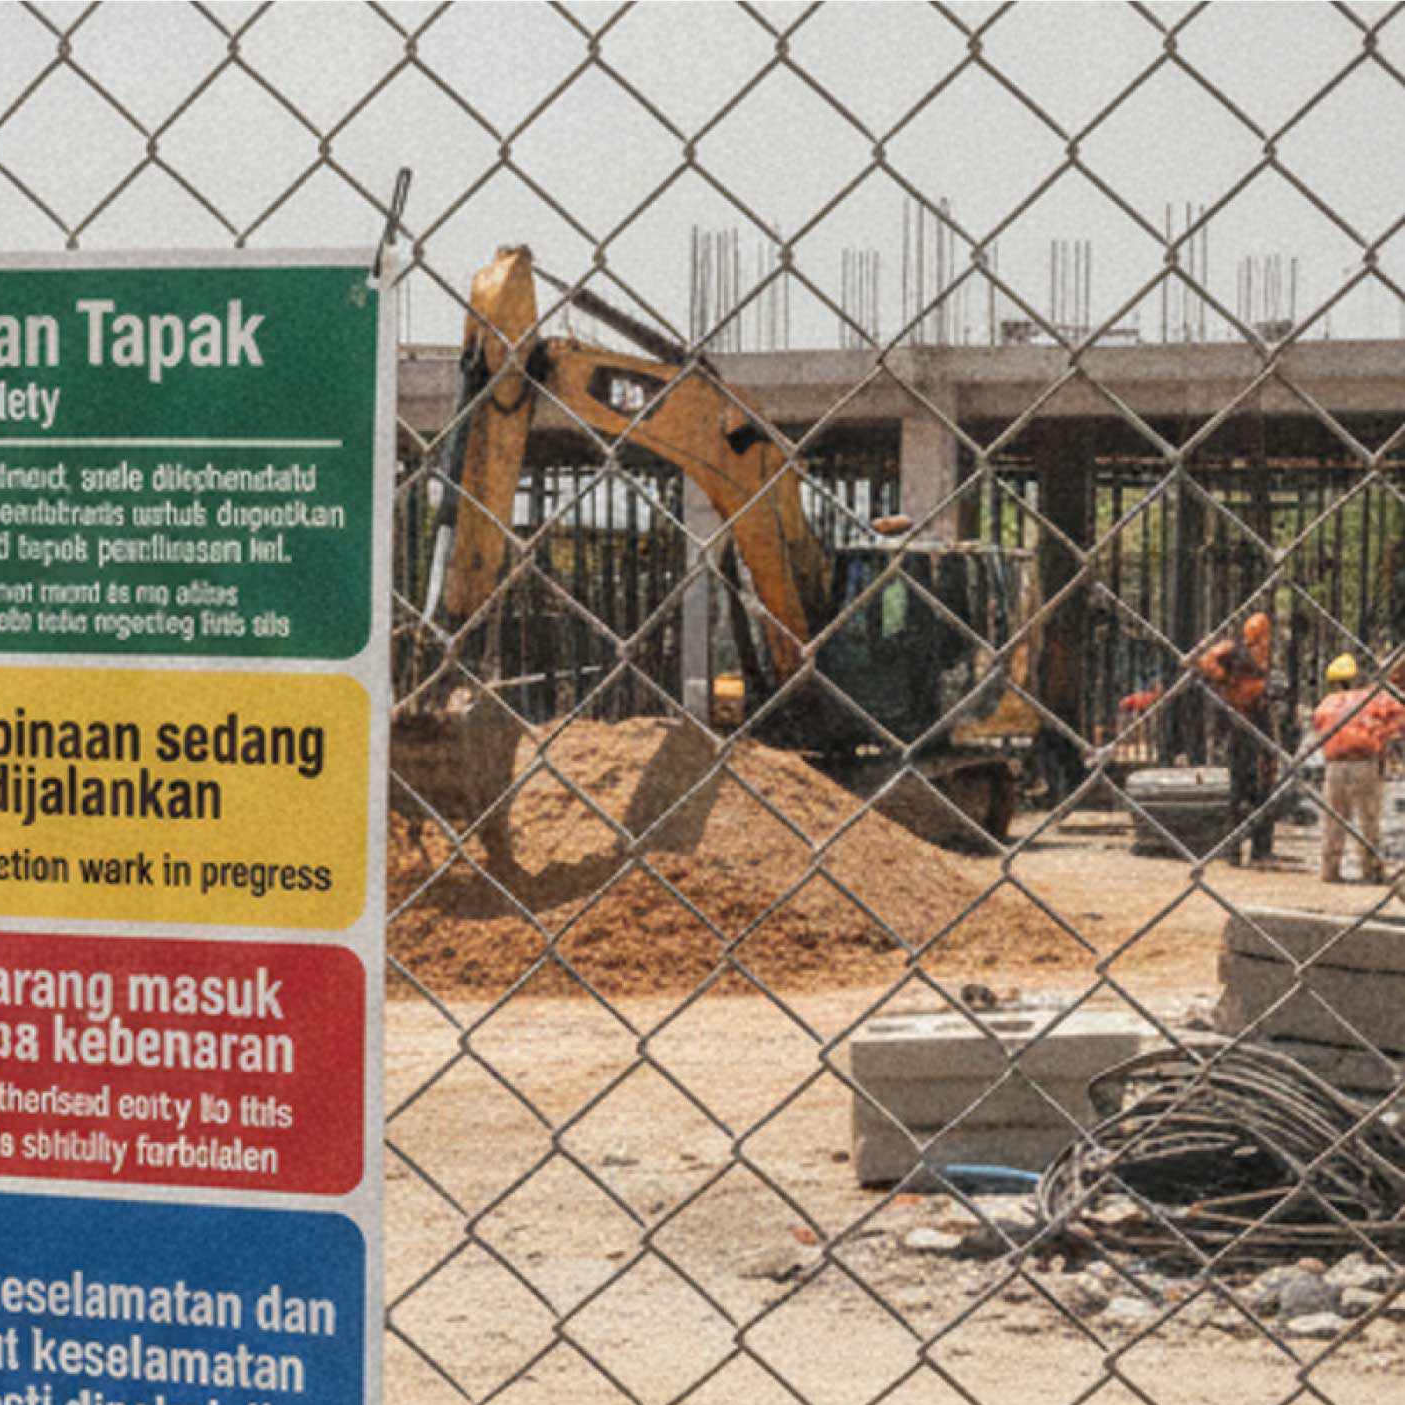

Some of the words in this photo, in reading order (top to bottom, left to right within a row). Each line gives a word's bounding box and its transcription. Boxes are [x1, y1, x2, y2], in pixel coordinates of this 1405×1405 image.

[77, 300, 264, 383] Tapak
[157, 713, 323, 778] sedang
[163, 853, 191, 886] in
[129, 968, 283, 1018] masuk
[54, 1015, 296, 1073] kebenaran
[256, 1285, 335, 1335] dan
[32, 1327, 304, 1393] keselamatan
